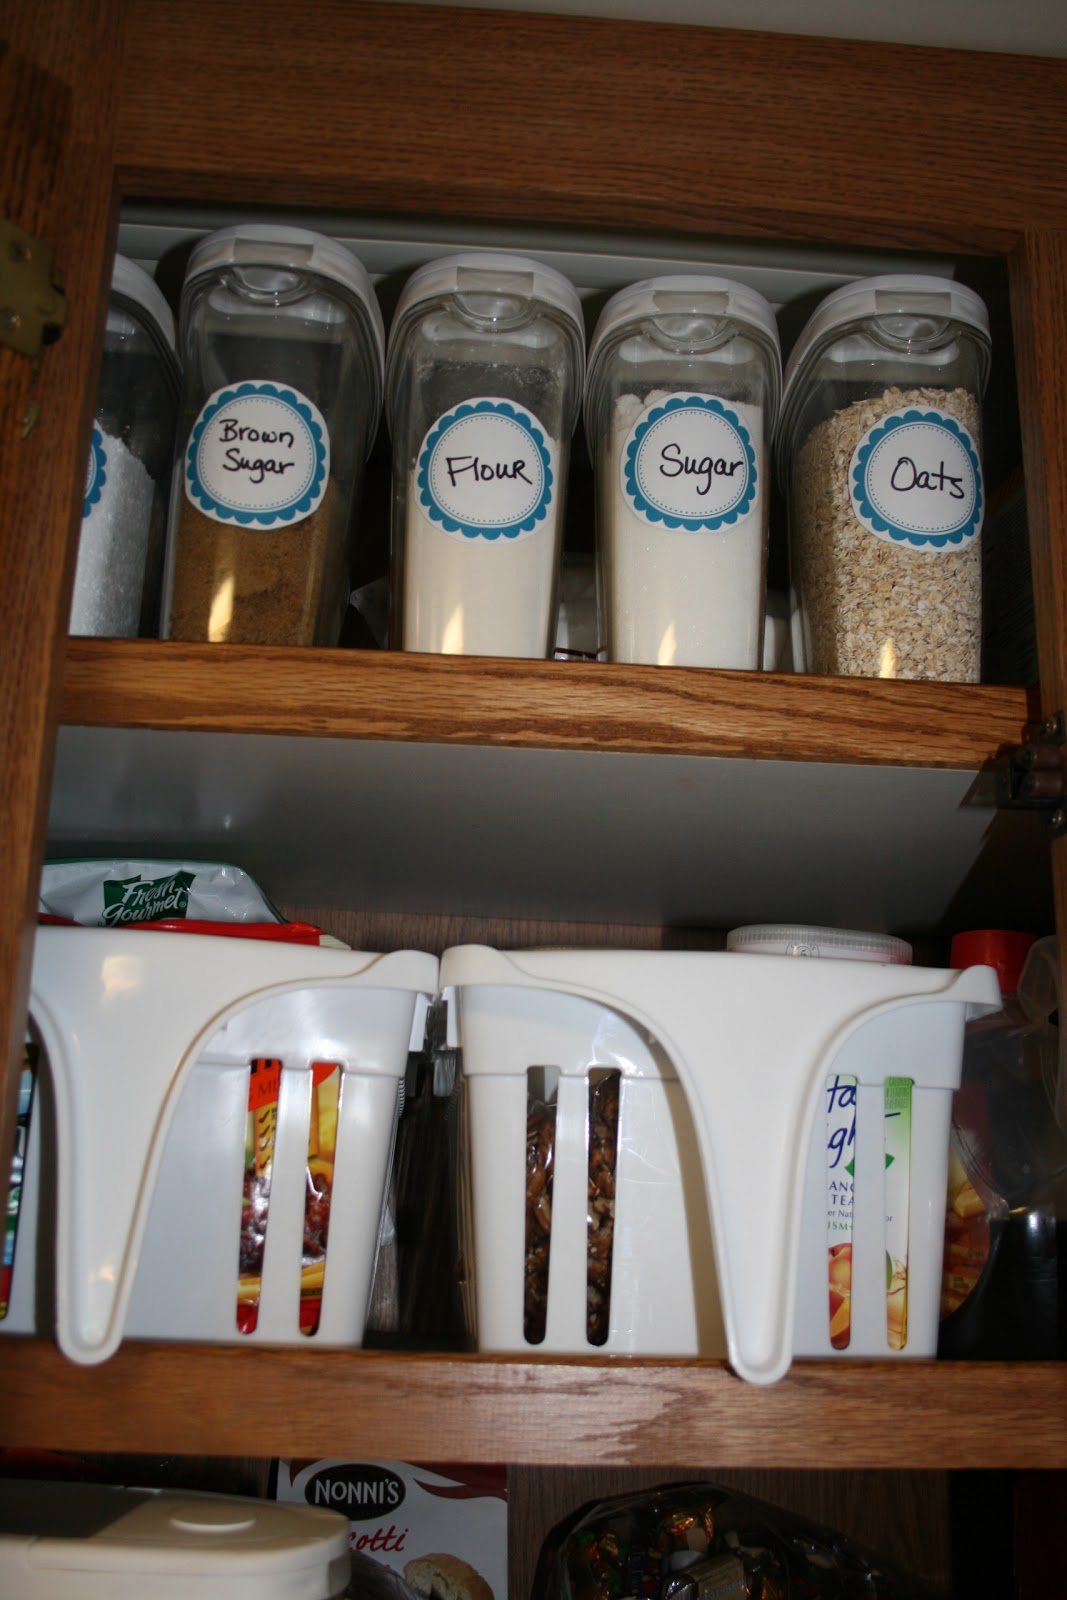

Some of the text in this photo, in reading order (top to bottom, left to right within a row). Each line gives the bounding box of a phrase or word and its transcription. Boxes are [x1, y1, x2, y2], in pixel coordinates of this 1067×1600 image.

[218, 419, 294, 447] Brown
[222, 448, 295, 484] Sugar
[659, 443, 744, 495] Sugar
[890, 457, 965, 499] Oats
[102, 887, 188, 927] Gourmet
[121, 879, 176, 906] Fresh
[315, 1479, 399, 1504] NONNI'S
